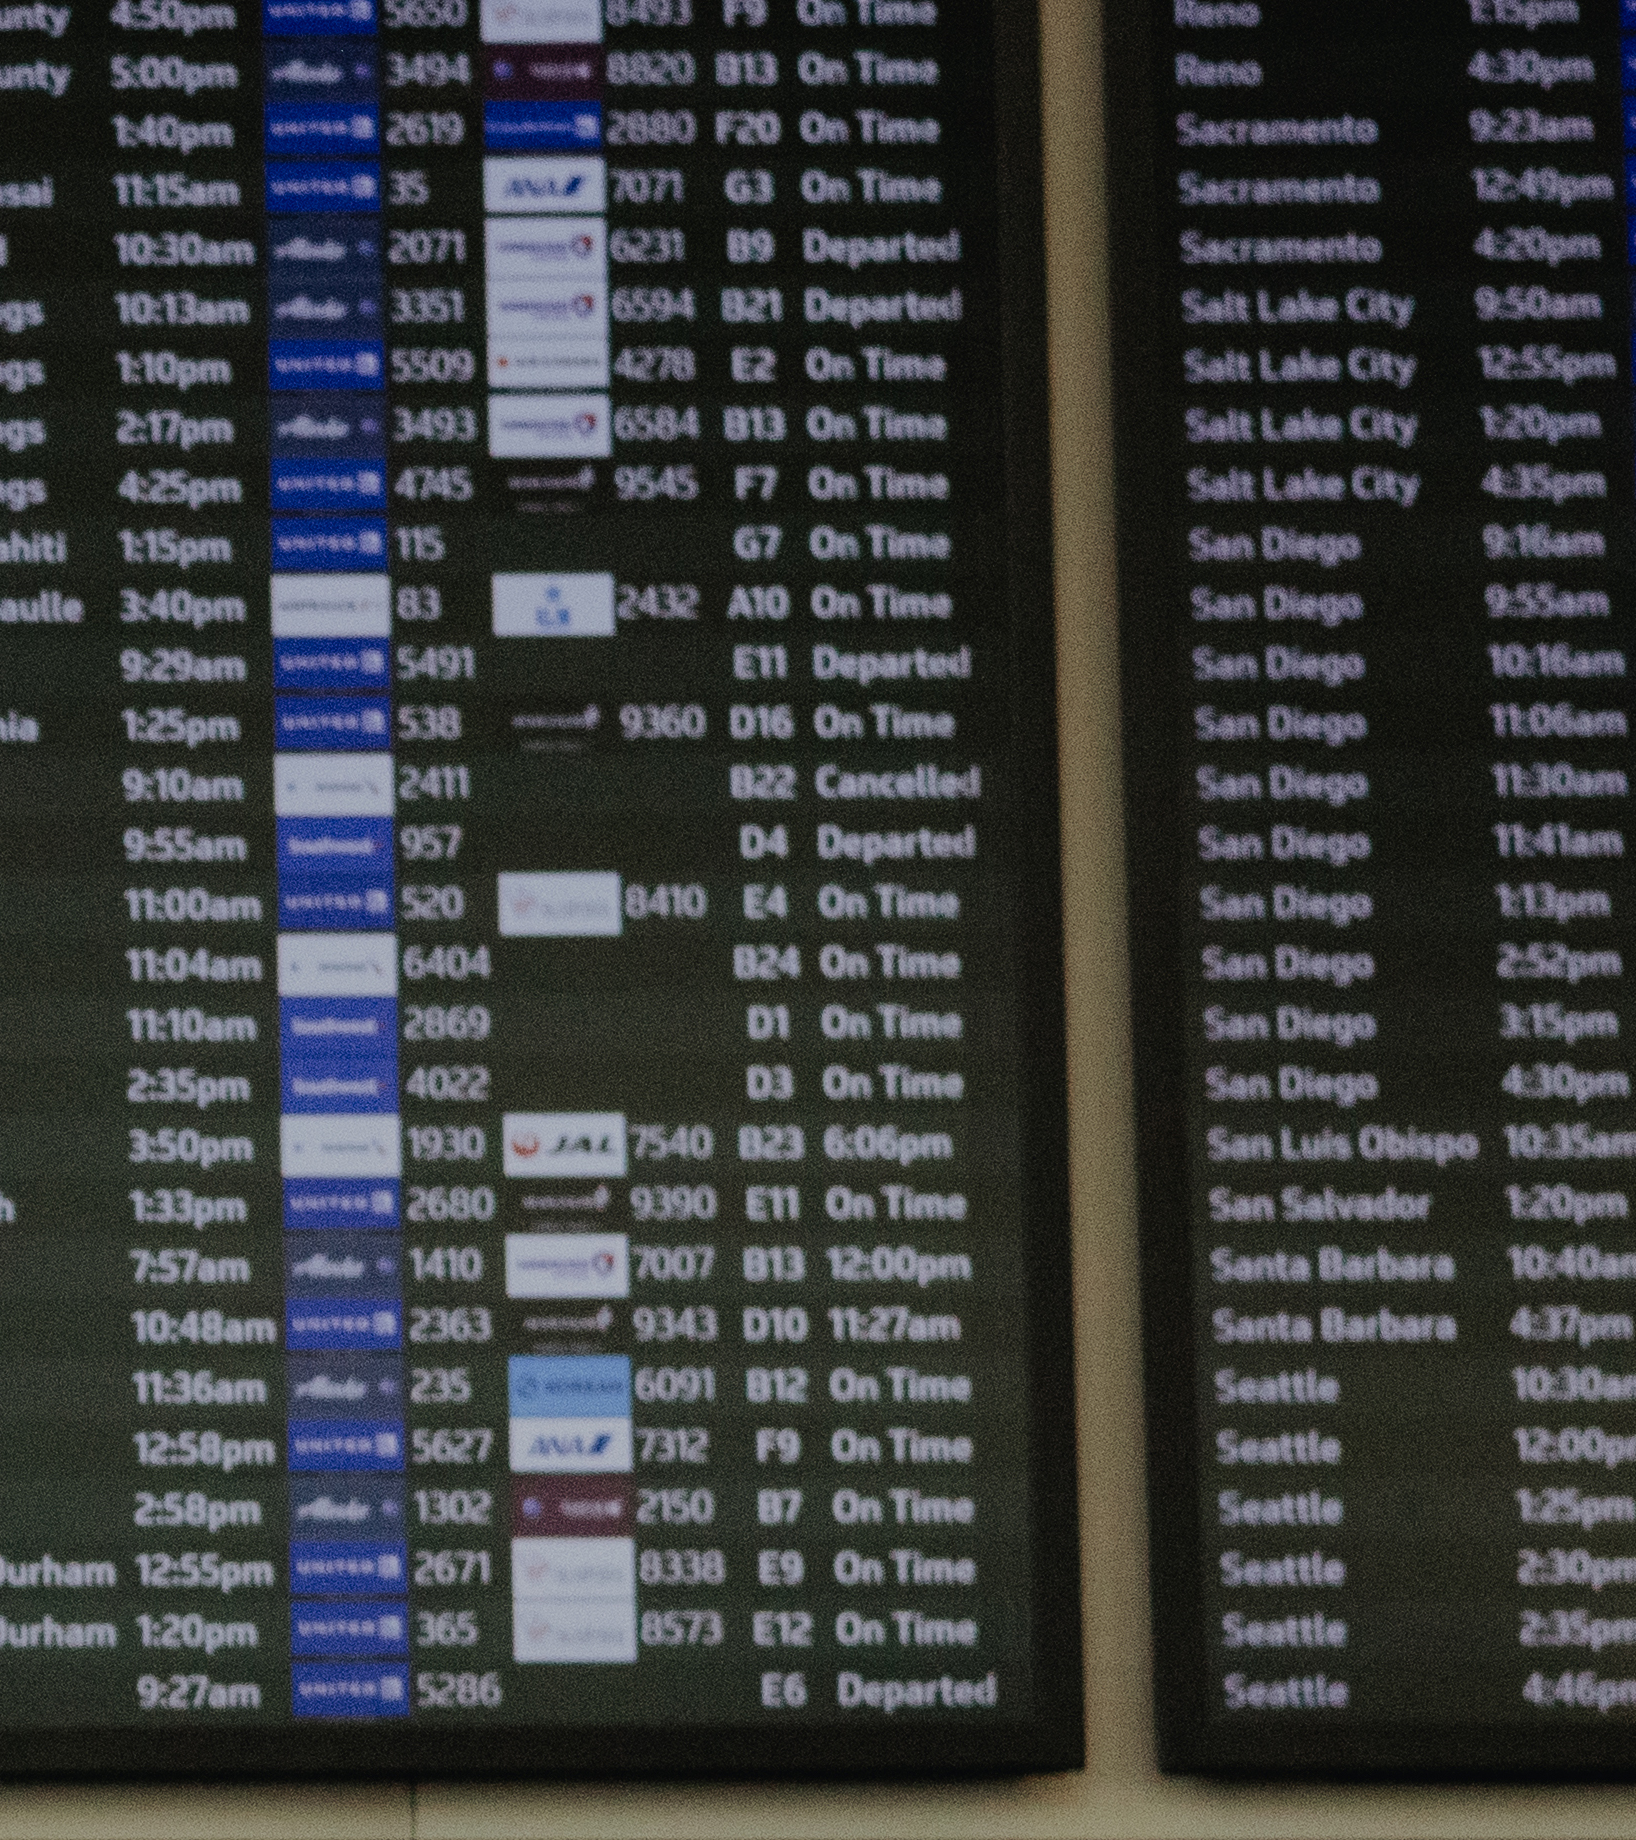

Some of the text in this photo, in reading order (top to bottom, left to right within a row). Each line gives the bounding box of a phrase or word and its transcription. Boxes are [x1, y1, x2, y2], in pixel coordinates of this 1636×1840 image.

[118, 470, 242, 509] 4:25pm
[395, 467, 473, 500] 4745
[735, 466, 778, 499] F7
[808, 466, 857, 500] On
[865, 465, 949, 499] Time
[1188, 469, 1254, 501] Salt
[1263, 469, 1345, 500] Lake
[1351, 466, 1420, 506] City
[1202, 945, 1374, 986] San Diego
[137, 1613, 258, 1654] 1:20pm
[419, 1611, 478, 1645] 365
[753, 1611, 813, 1646] E12
[1223, 1613, 1347, 1646] Seattle
